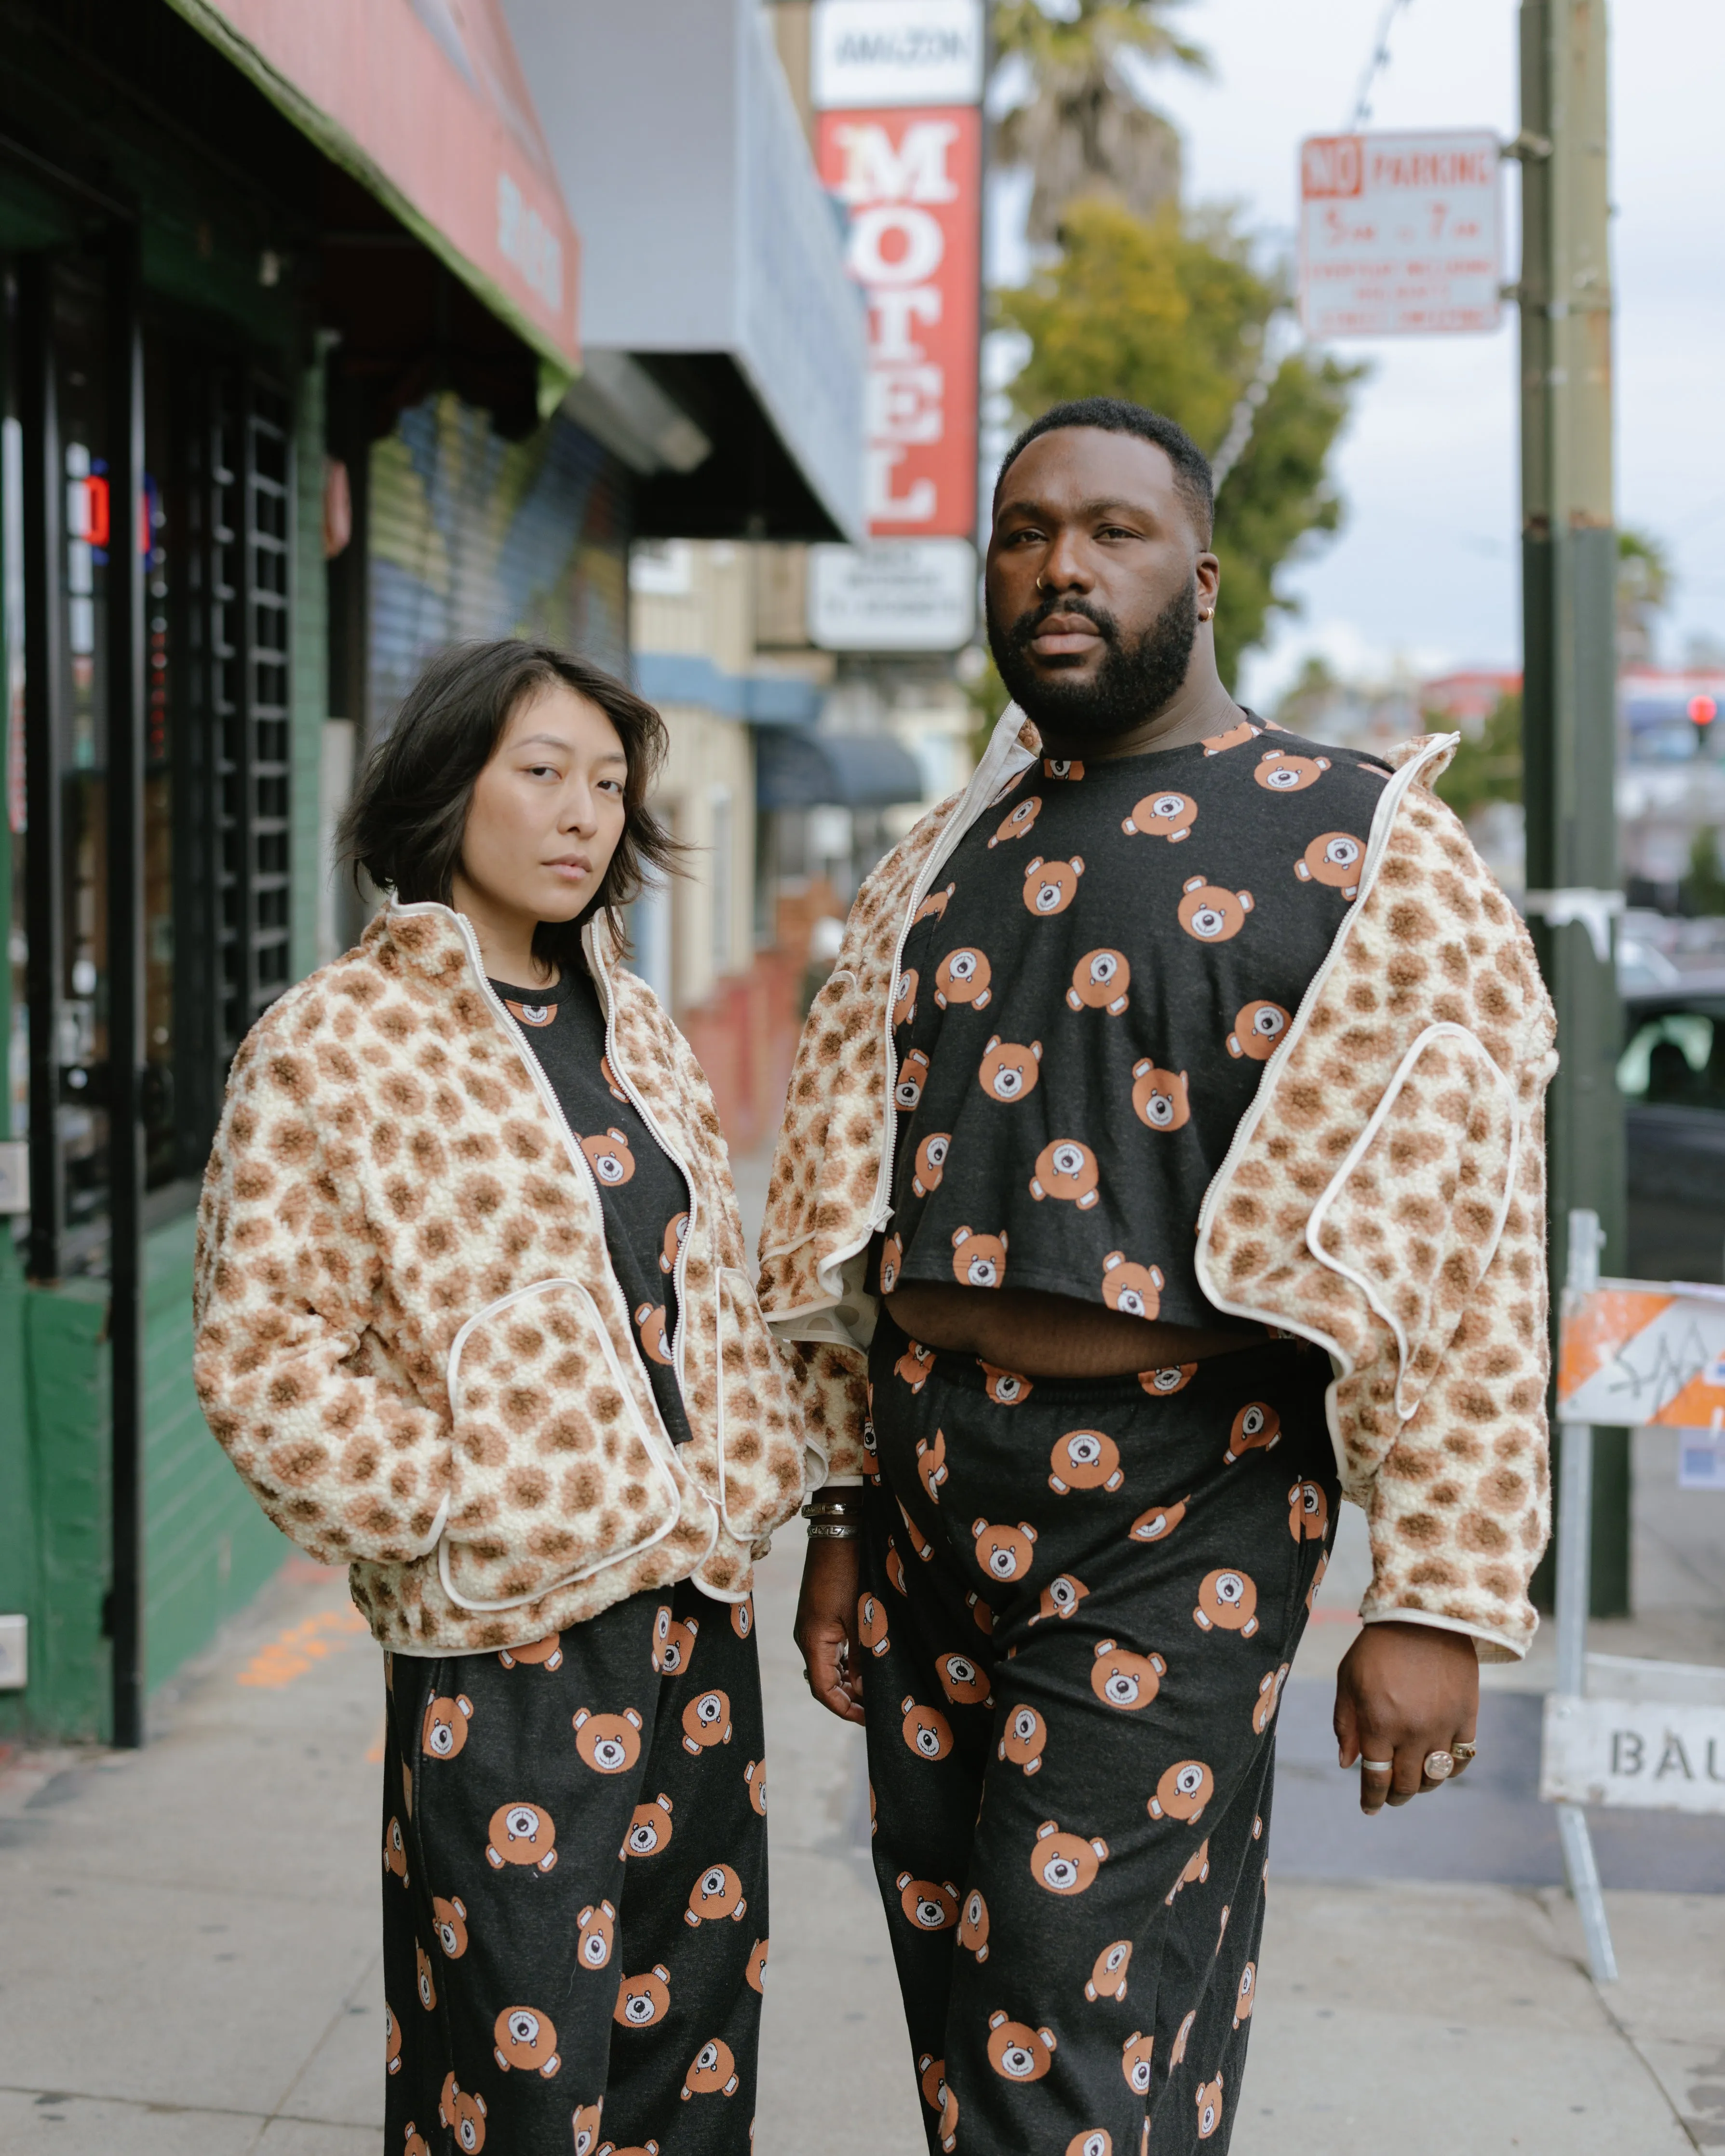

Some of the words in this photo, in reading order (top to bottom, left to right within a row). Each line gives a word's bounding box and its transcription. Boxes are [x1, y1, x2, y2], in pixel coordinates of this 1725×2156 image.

[1304, 143, 1356, 192] NO
[1372, 150, 1494, 187] PARKING
[834, 121, 960, 522] MOTEL
